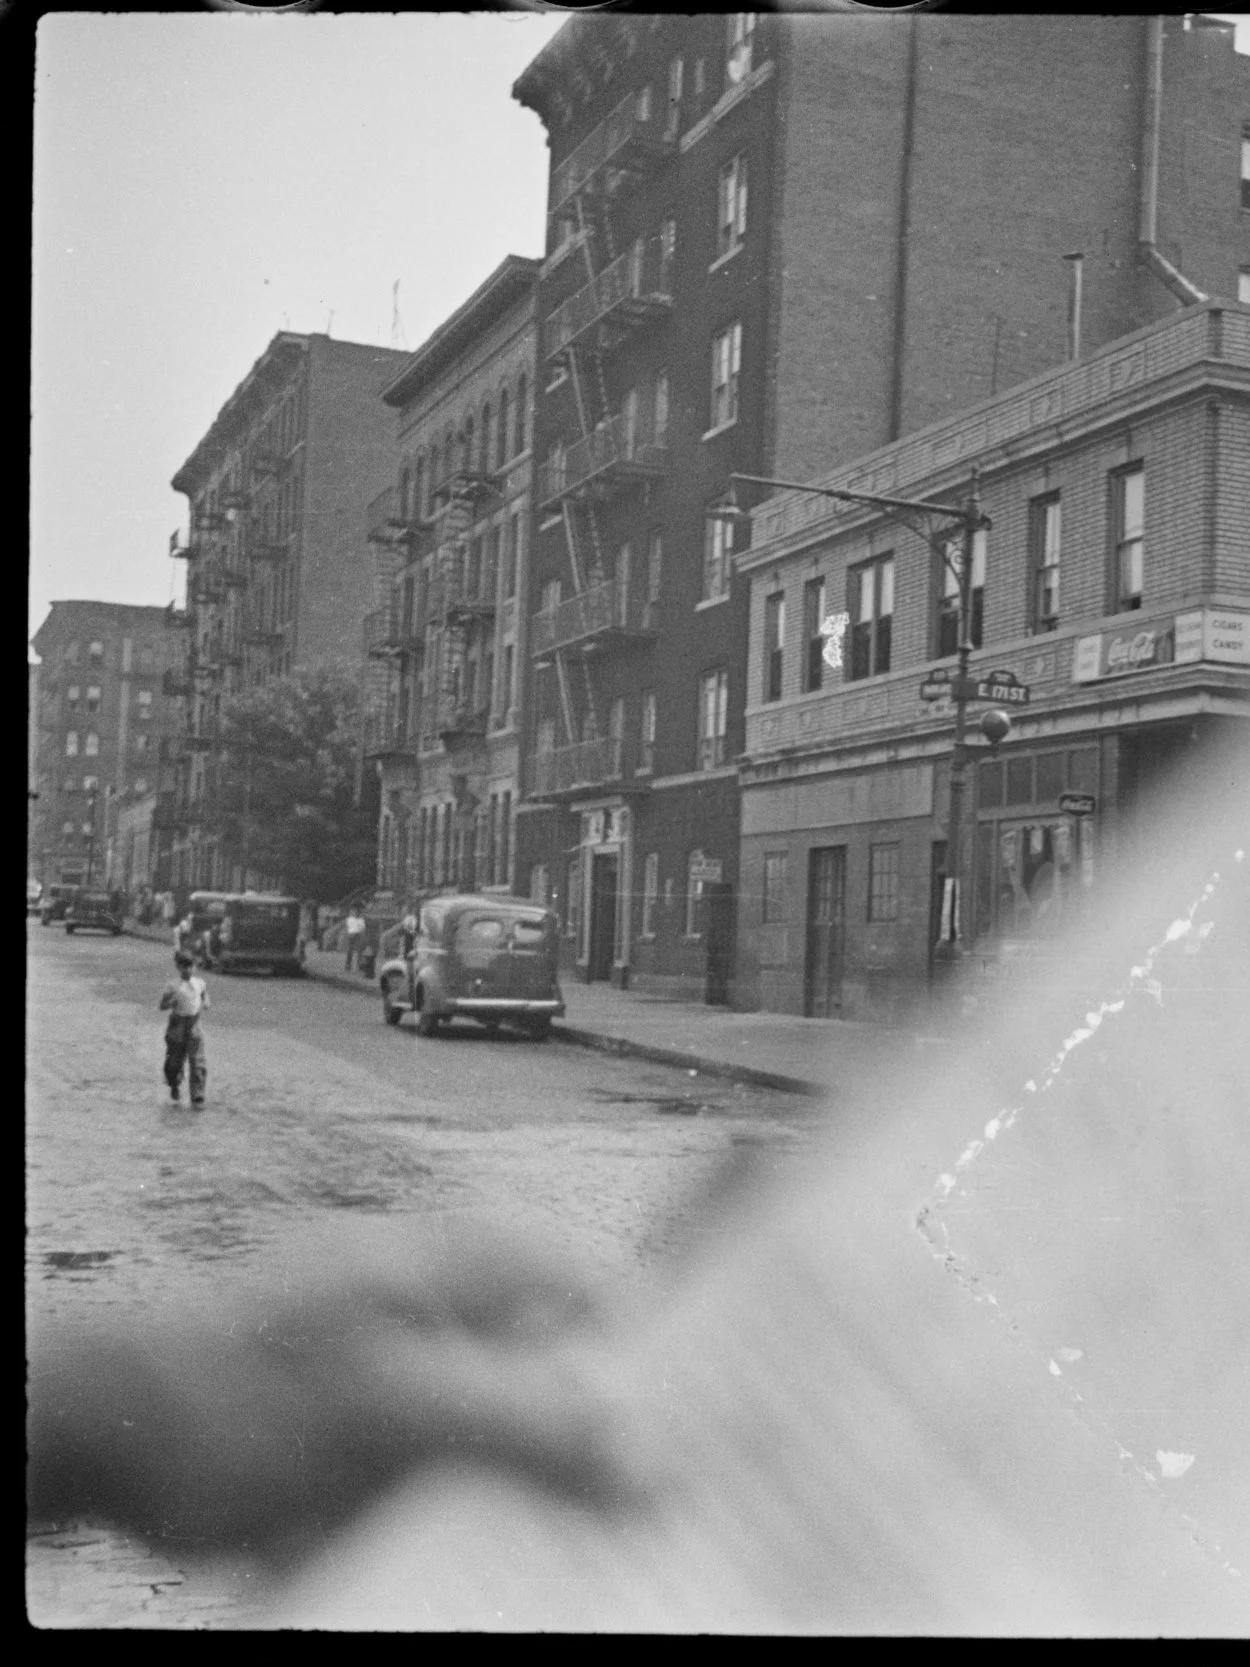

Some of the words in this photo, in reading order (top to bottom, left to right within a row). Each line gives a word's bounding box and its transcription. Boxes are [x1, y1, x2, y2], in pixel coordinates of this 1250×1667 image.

[1211, 619, 1244, 631] CIGARS
[1211, 638, 1245, 650] CANDY
[978, 683, 989, 697] E
